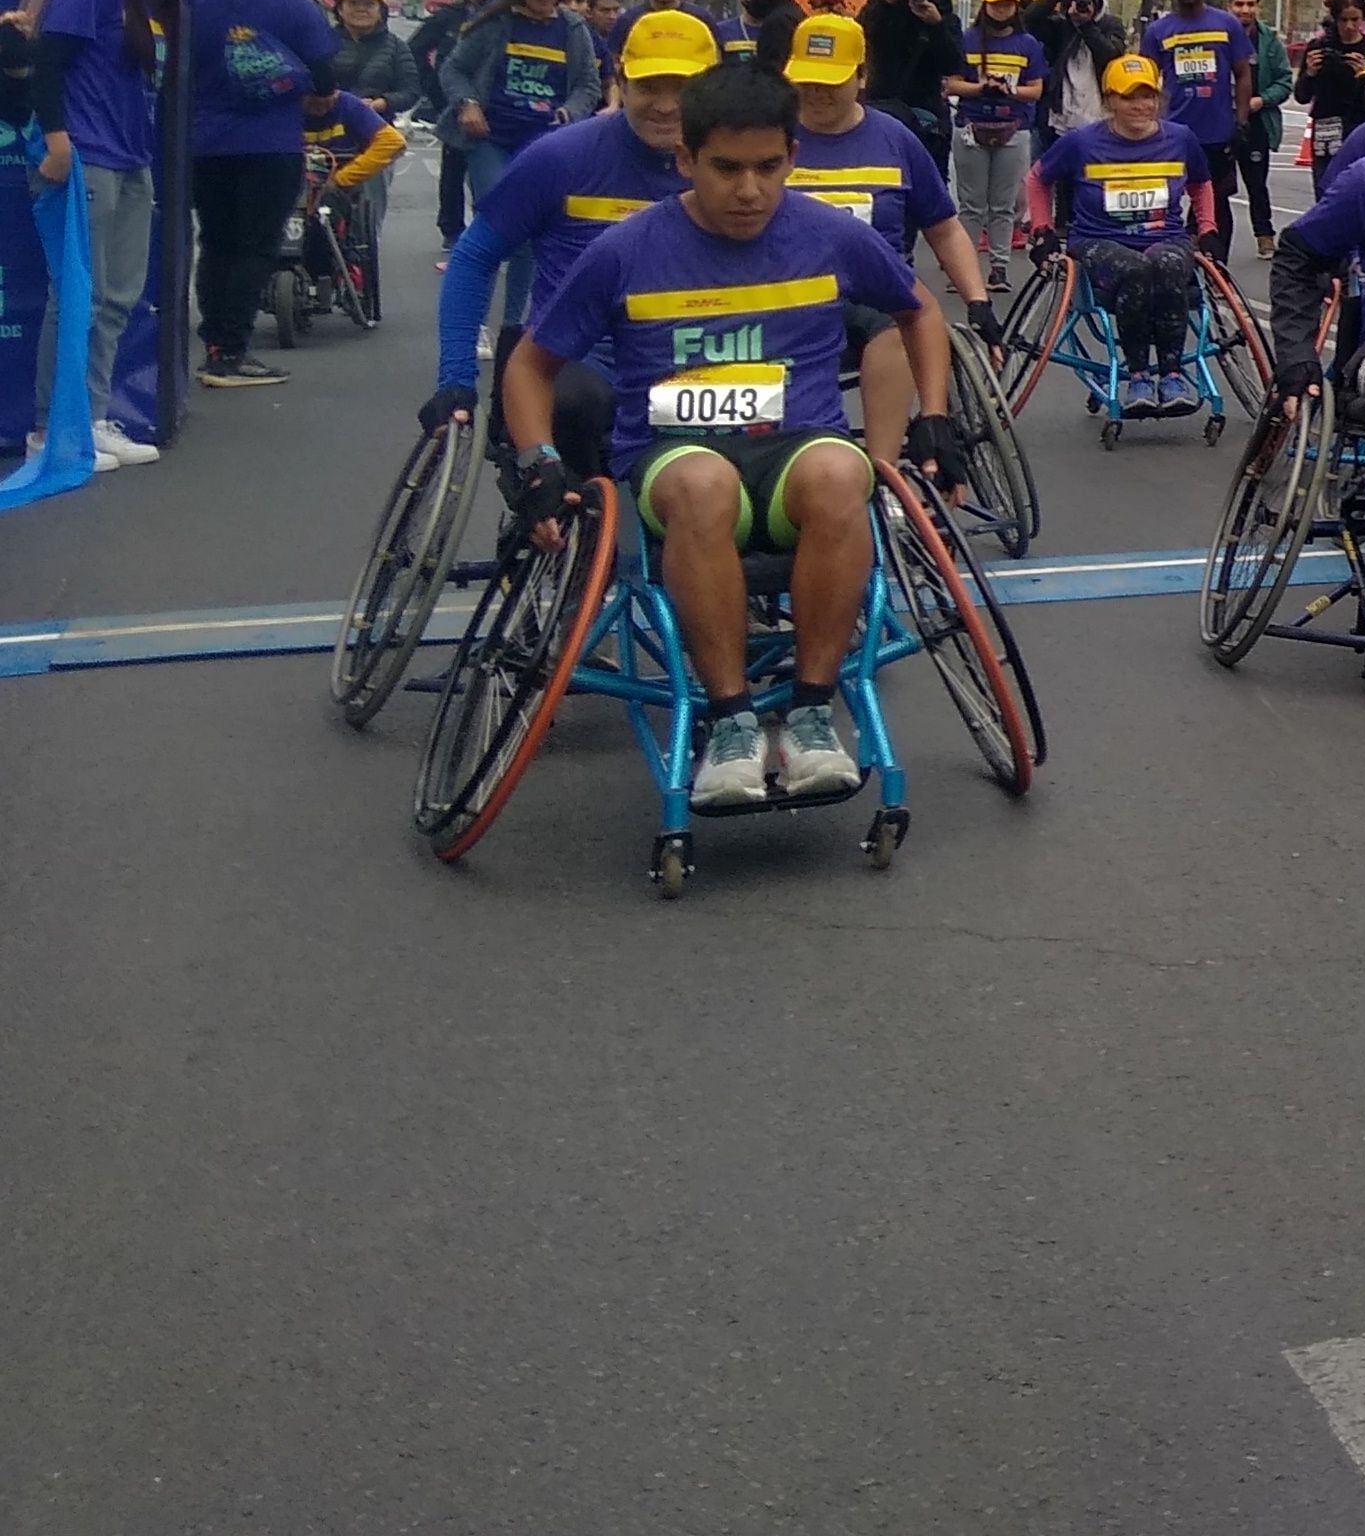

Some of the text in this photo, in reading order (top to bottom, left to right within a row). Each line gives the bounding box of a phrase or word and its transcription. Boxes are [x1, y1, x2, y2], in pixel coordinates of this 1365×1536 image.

[506, 57, 549, 79] Full
[1183, 60, 1209, 73] 0015
[506, 77, 556, 97] Race
[1118, 191, 1156, 209] 0017
[672, 323, 763, 364] Full
[676, 388, 758, 422] 0043
